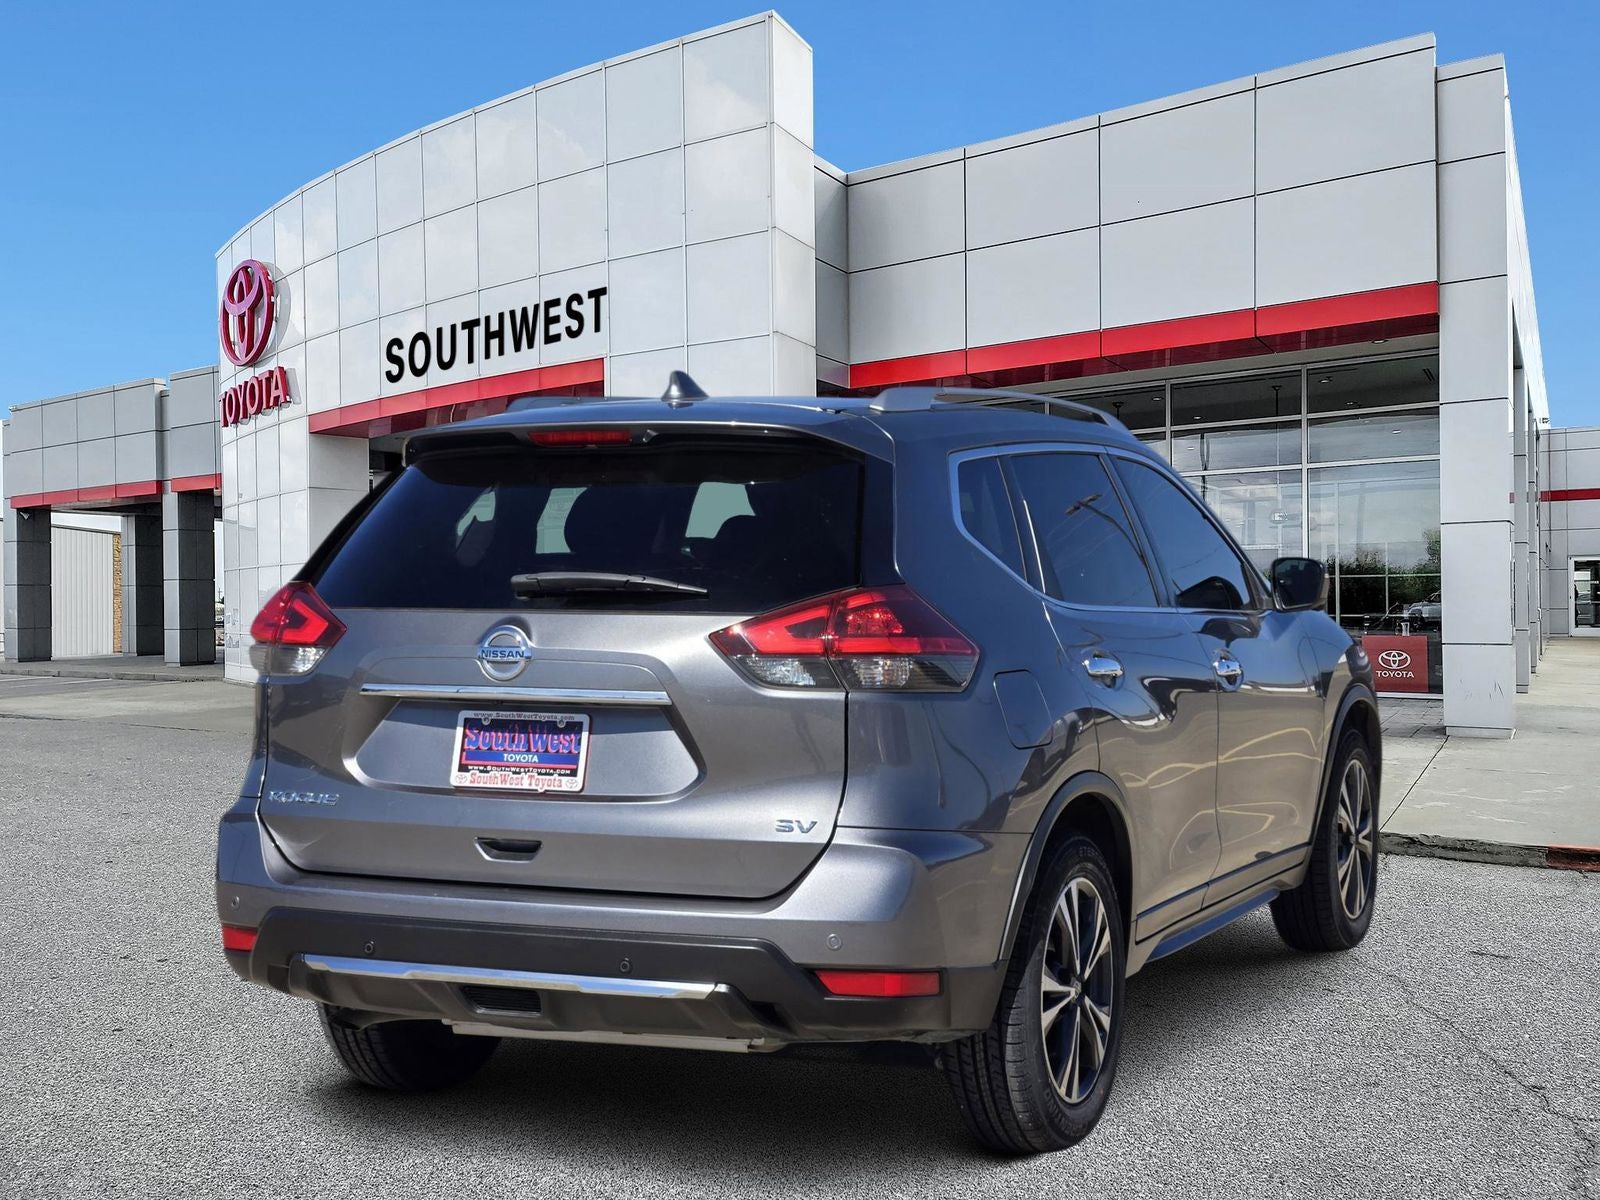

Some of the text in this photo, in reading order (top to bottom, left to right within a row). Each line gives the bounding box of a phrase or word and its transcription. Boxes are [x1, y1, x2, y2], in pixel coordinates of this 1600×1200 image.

[385, 286, 608, 384] SOUTHWEST
[218, 366, 291, 427] TOYOTA
[481, 649, 525, 658] NISSAN
[1375, 670, 1415, 678] TOYOTA
[503, 753, 539, 763] TOYOTA
[527, 774, 563, 790] Toyota
[775, 819, 818, 834] SV
